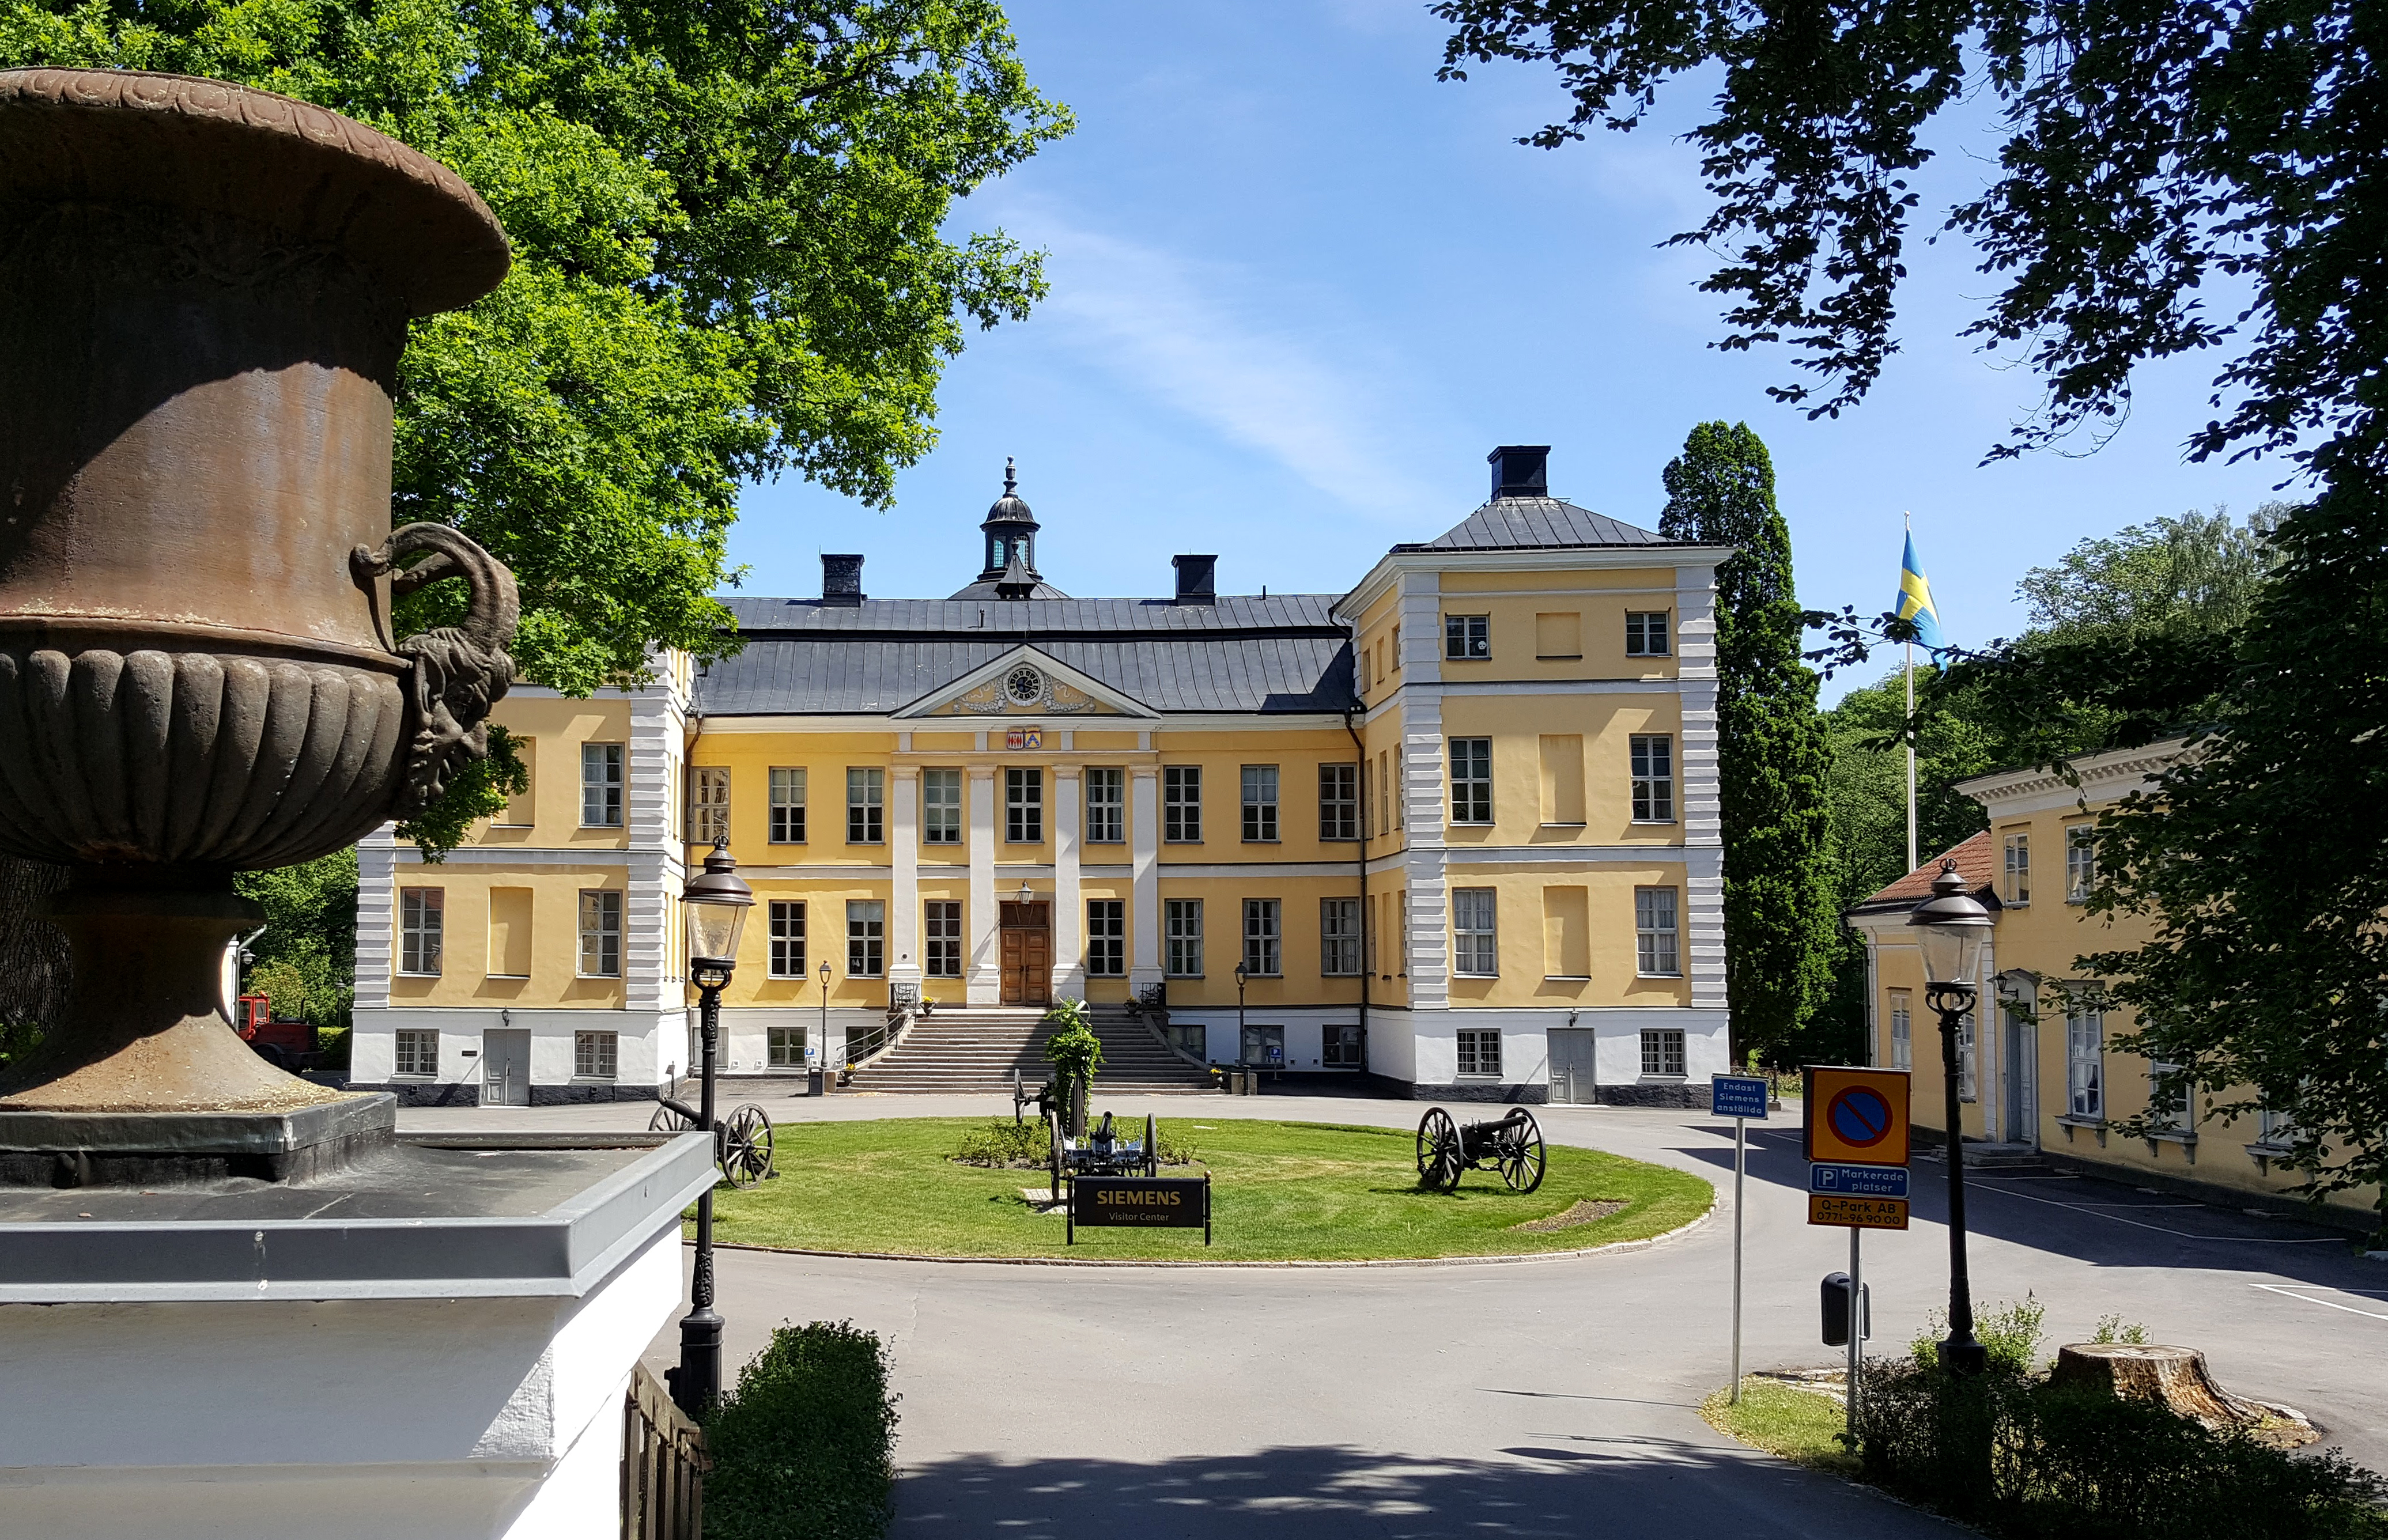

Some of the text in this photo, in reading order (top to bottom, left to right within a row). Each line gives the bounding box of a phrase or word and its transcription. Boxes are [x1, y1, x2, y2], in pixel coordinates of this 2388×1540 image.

[1723, 1082, 1756, 1092] Endast
[1719, 1092, 1760, 1103] Siemens
[1717, 1104, 1762, 1114] anställda
[1822, 1170, 1834, 1186] P
[1842, 1169, 1904, 1181] Markerade
[1852, 1182, 1893, 1193] platser
[1097, 1190, 1181, 1205] SIEMENS
[1822, 1200, 1896, 1214] Q-Park AB
[1108, 1212, 1169, 1221] Visitor Center
[1816, 1212, 1900, 1225] 0771-96 90 00
